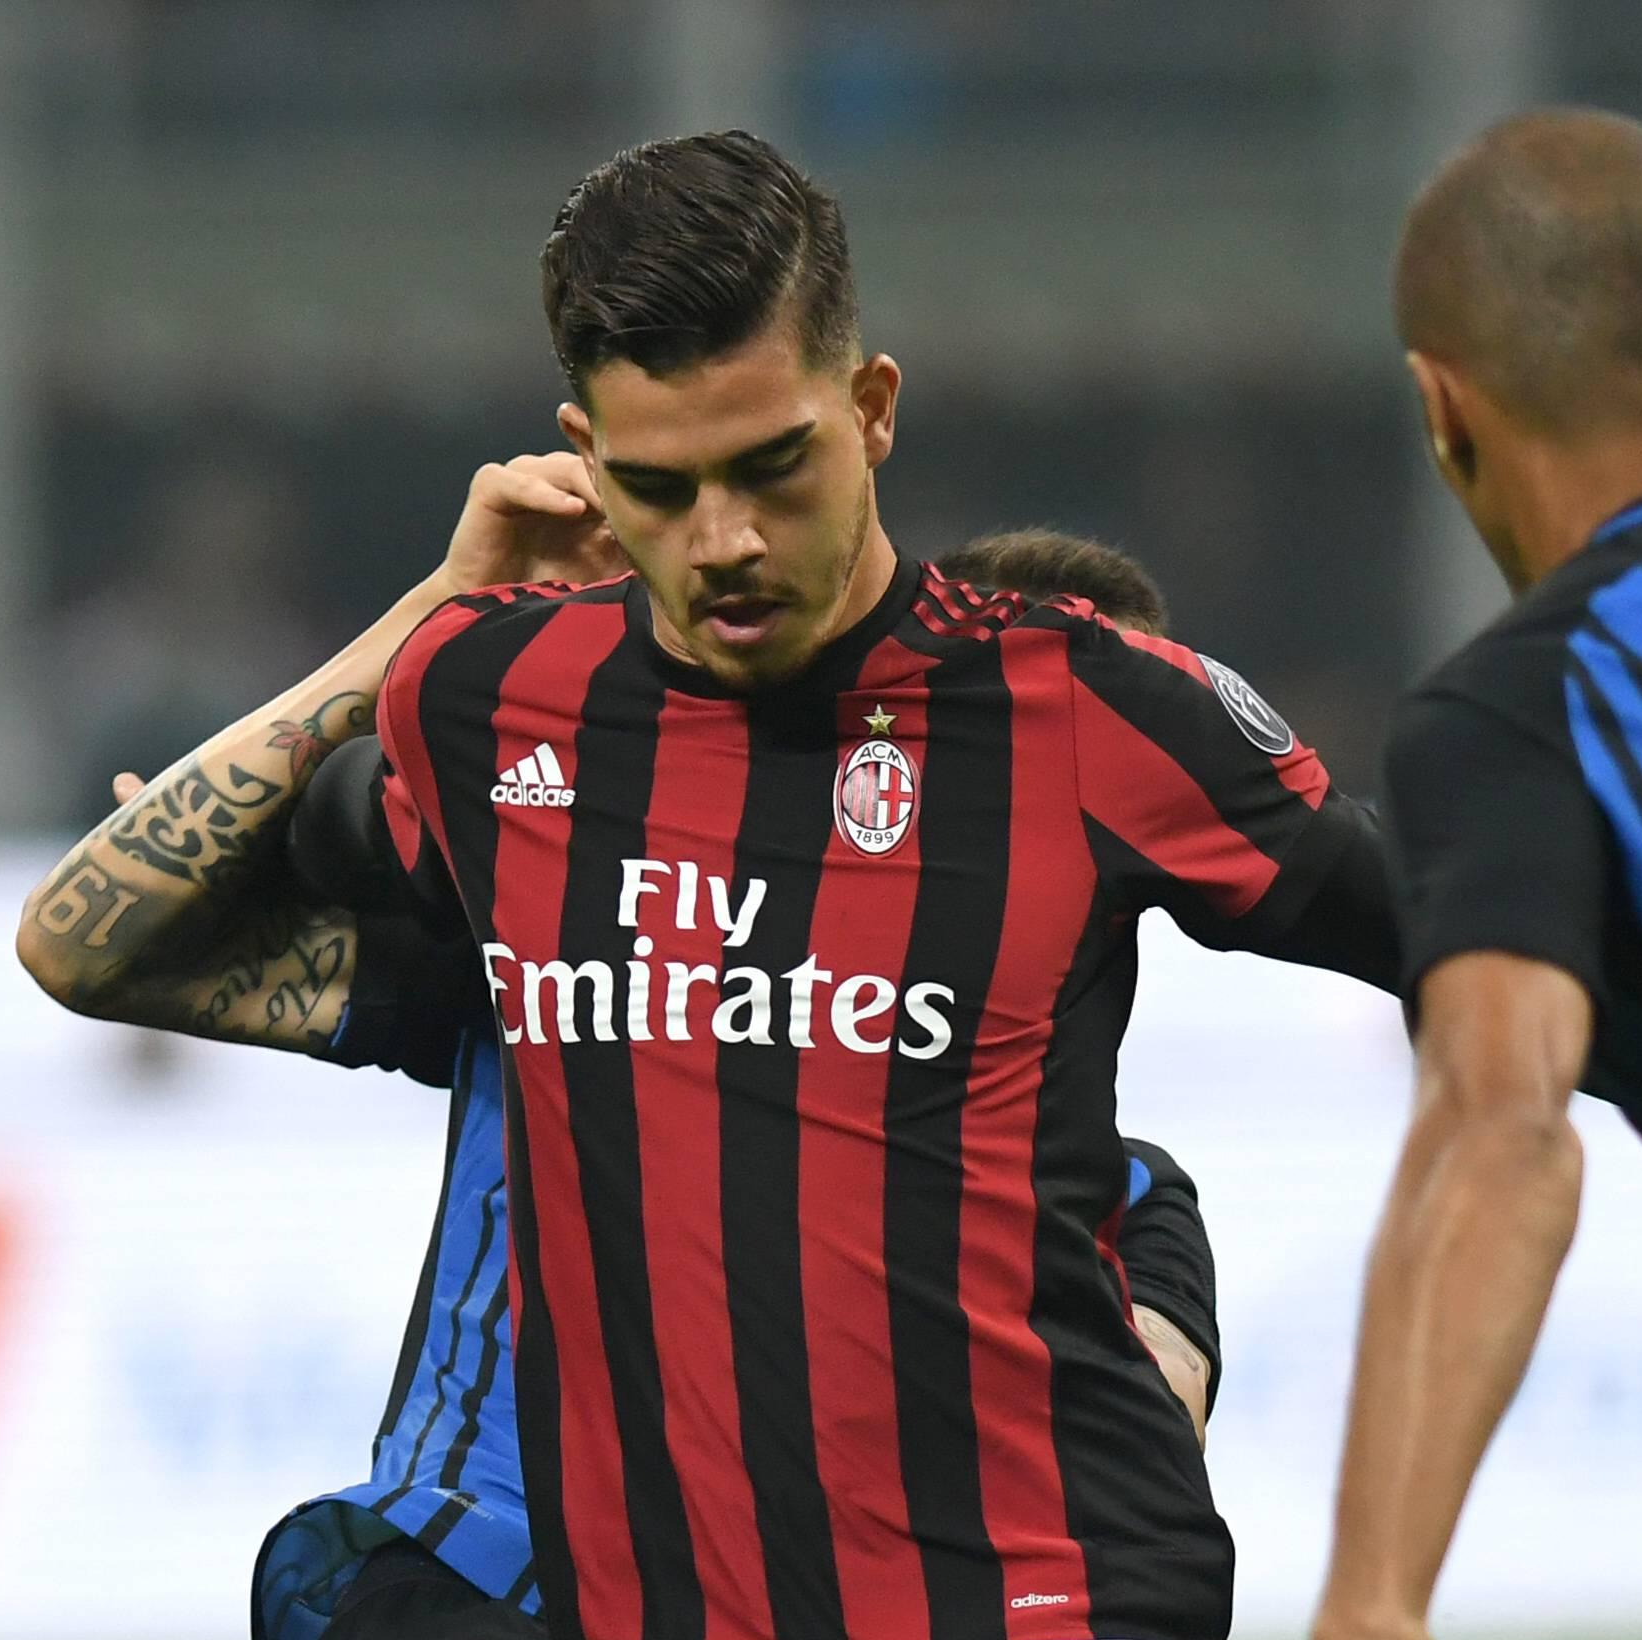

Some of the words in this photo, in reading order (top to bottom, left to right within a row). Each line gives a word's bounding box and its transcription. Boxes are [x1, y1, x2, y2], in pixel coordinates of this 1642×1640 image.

[857, 744, 902, 767] ACM
[489, 781, 577, 807] adidas
[856, 829, 895, 845] 1899
[617, 858, 768, 948] Fly
[482, 935, 956, 1060] Emirates
[1010, 1592, 1070, 1609] adizero
